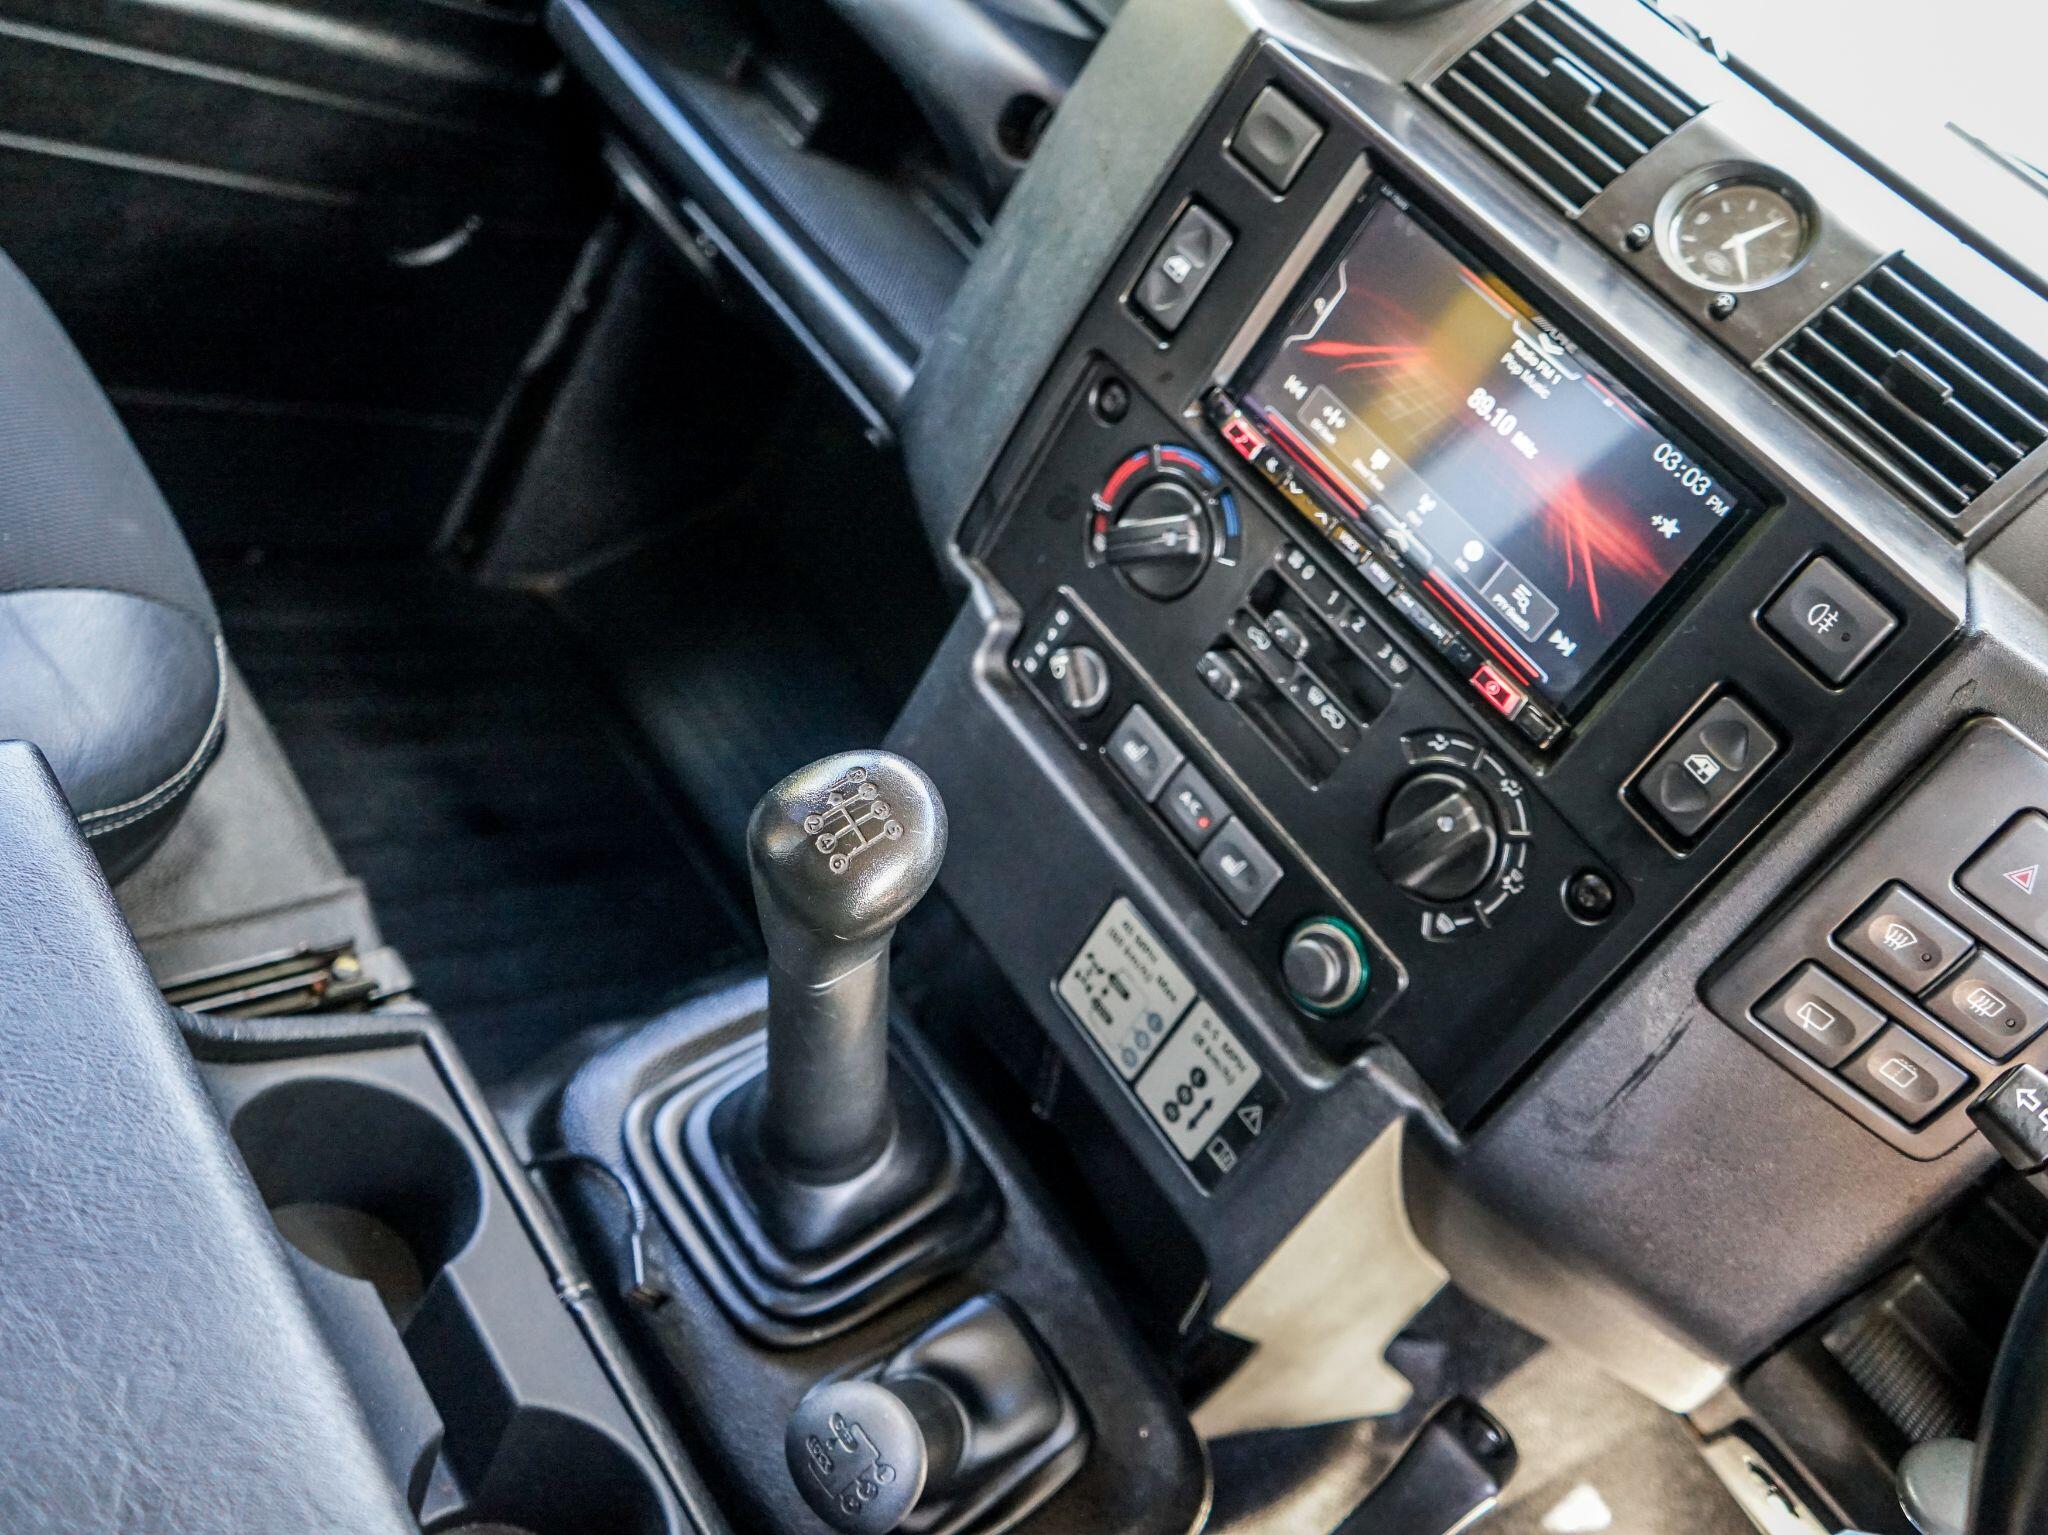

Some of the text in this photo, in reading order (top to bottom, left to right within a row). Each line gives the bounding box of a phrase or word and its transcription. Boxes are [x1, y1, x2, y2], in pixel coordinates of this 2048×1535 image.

[1500, 352, 1551, 399] Pop Music
[1511, 339, 1562, 385] Radio FM 1
[1466, 387, 1517, 436] 89.10
[1653, 443, 1730, 517] 03:03 PM
[1302, 565, 1316, 580] 0
[1327, 590, 1340, 605] 1
[1351, 616, 1366, 633] 2
[1377, 643, 1393, 659] 3
